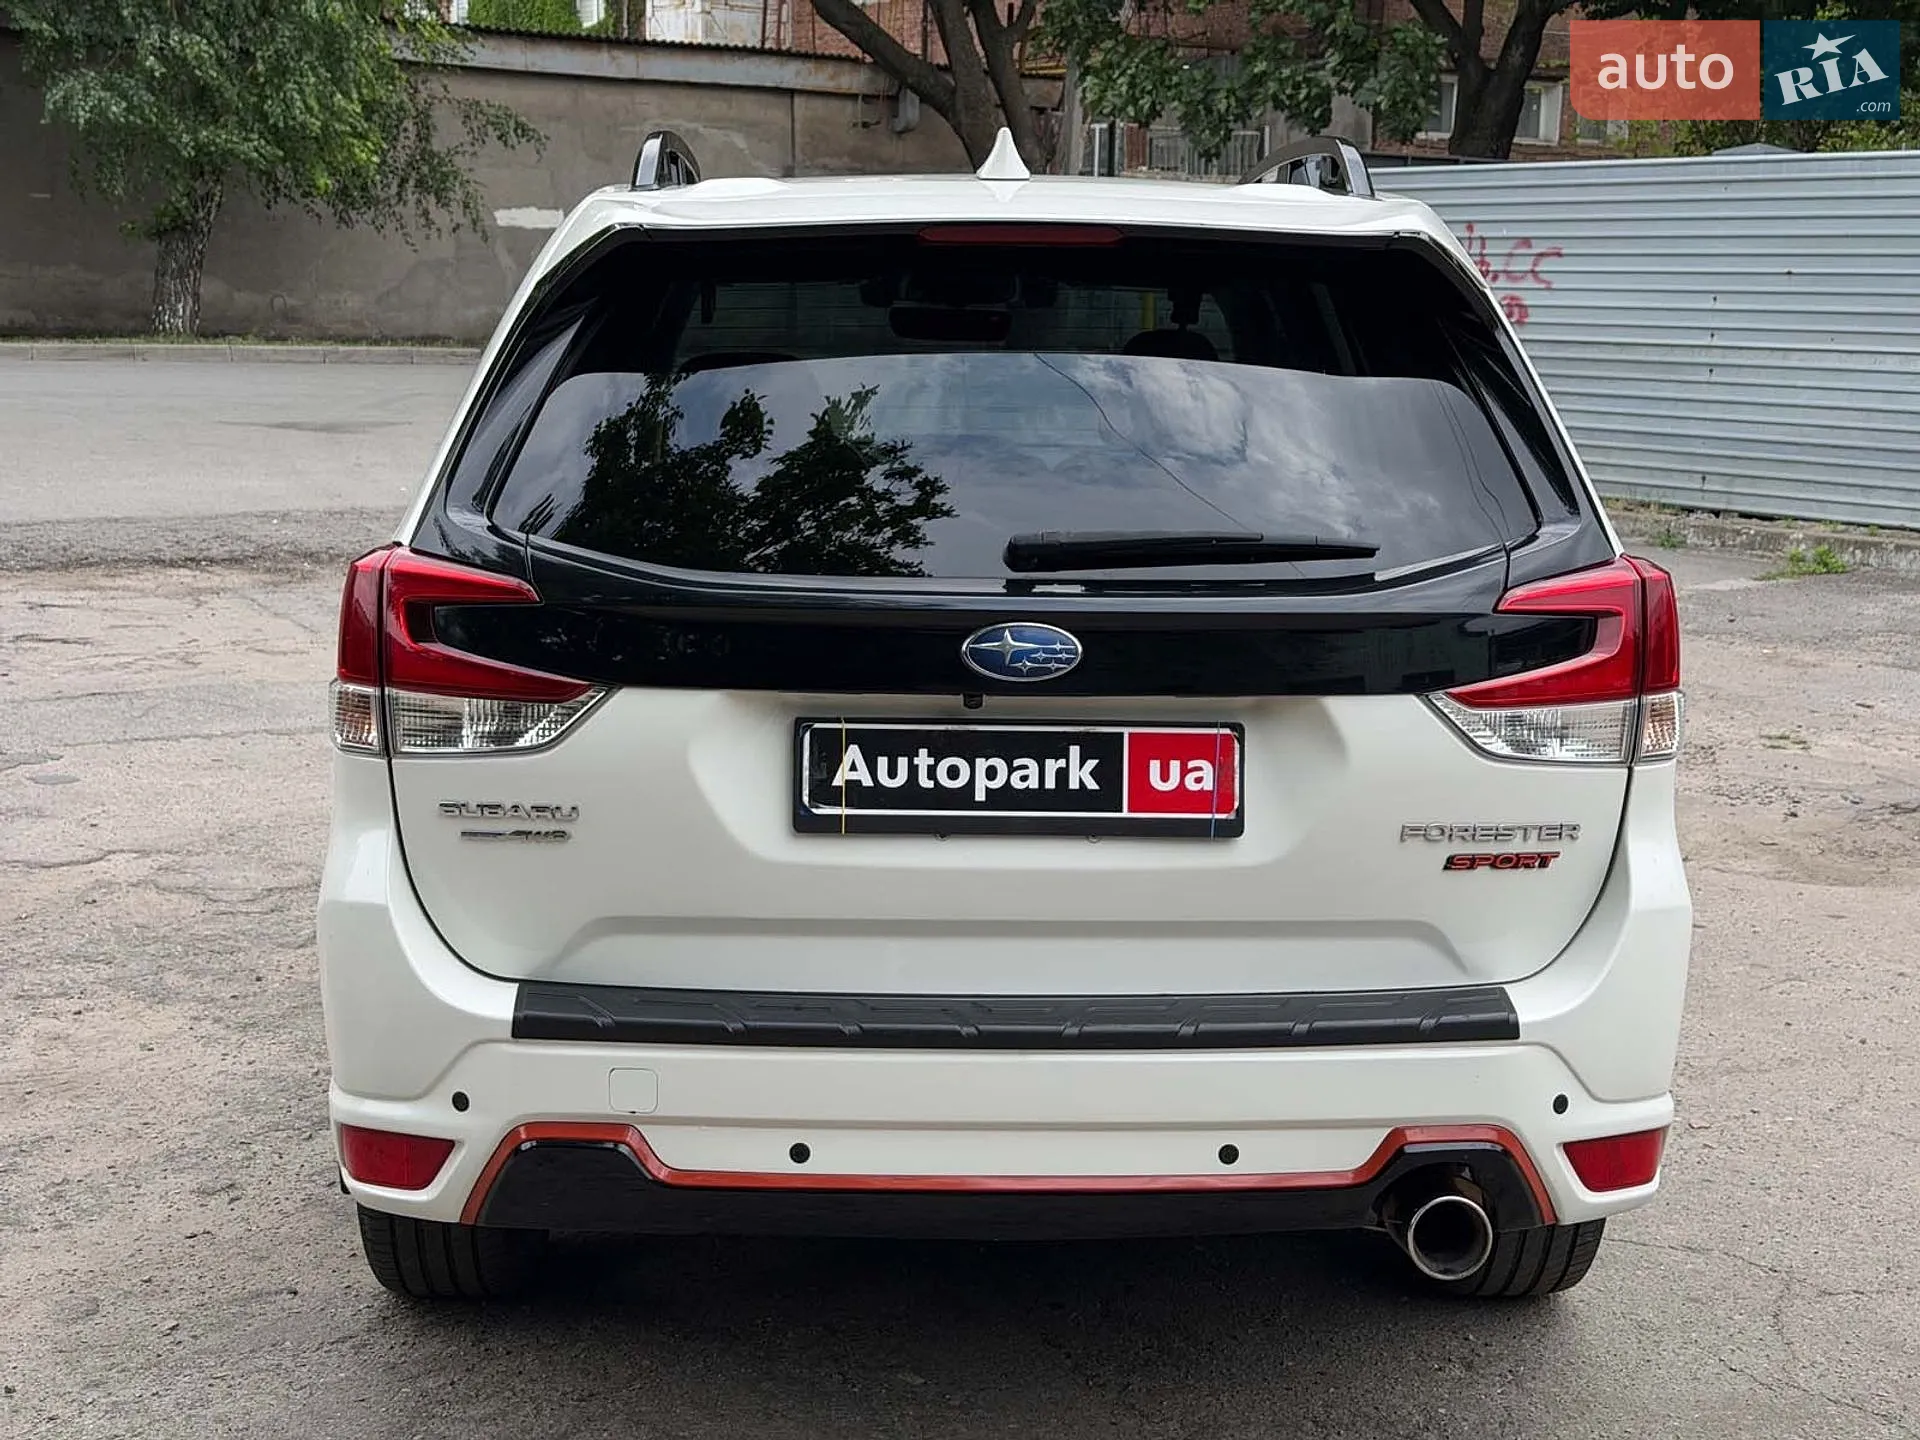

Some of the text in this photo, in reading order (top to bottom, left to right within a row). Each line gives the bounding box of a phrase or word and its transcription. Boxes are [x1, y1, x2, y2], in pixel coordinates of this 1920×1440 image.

[831, 744, 1214, 802] Autopark ua
[438, 801, 580, 820] SUBARU
[1400, 822, 1581, 842] FORESTER
[1446, 851, 1561, 870] SPORT
